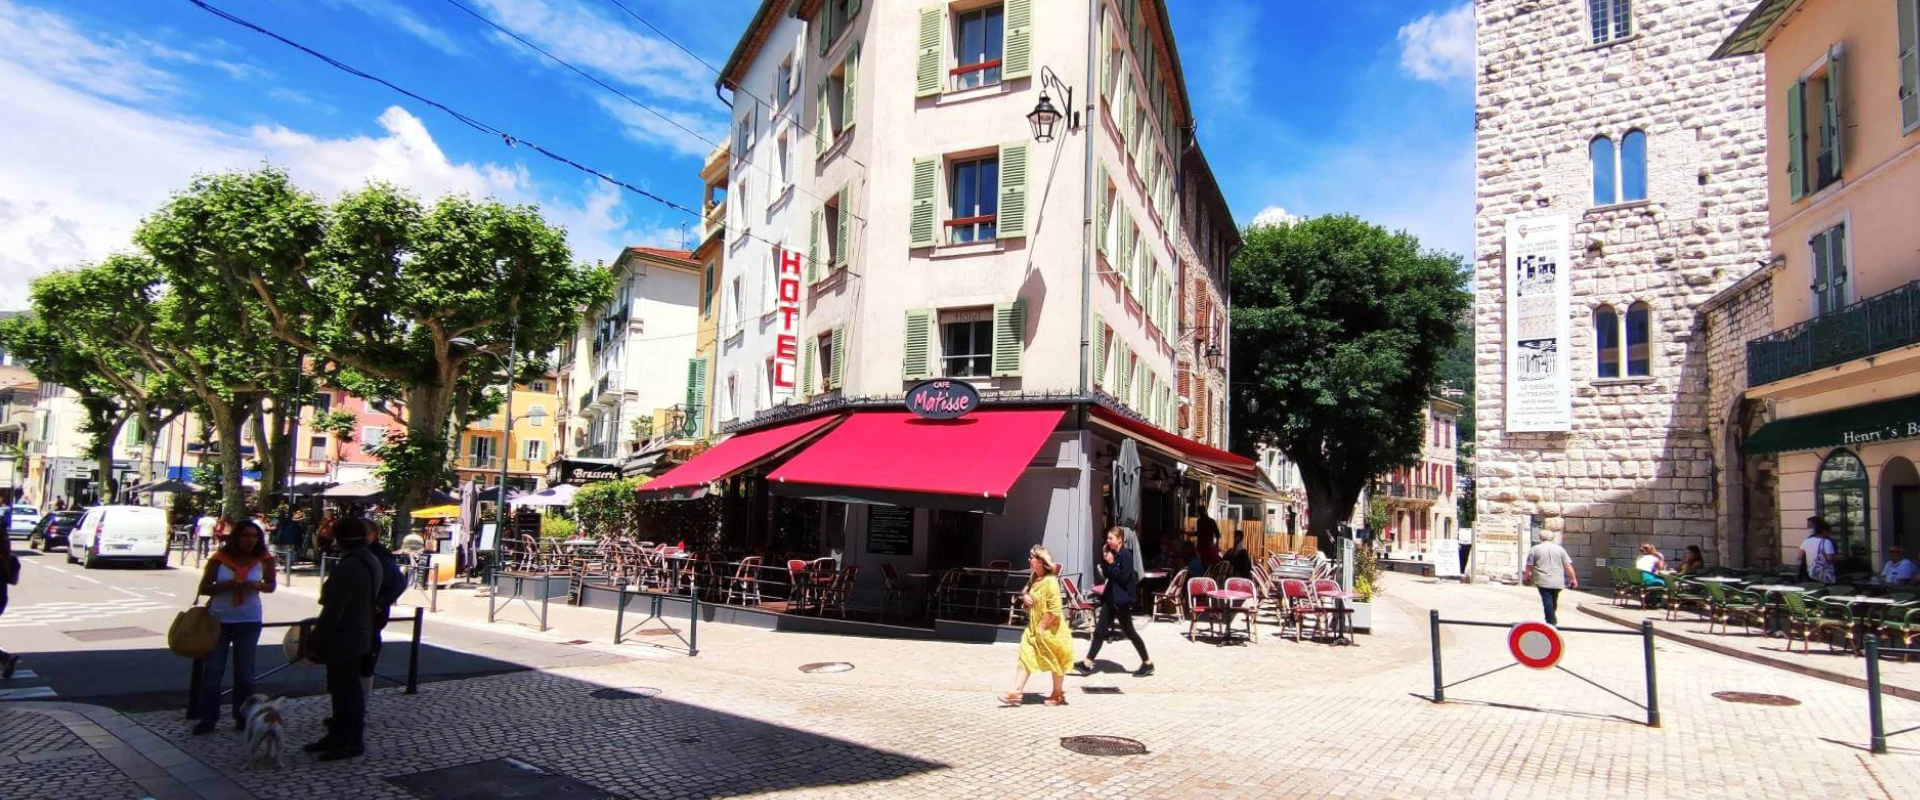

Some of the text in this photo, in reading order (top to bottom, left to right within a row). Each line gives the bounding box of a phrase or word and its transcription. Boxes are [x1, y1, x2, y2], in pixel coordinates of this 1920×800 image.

[774, 250, 801, 387] HOTEL
[913, 390, 969, 412] Matisse
[573, 468, 619, 480] Brasserie
